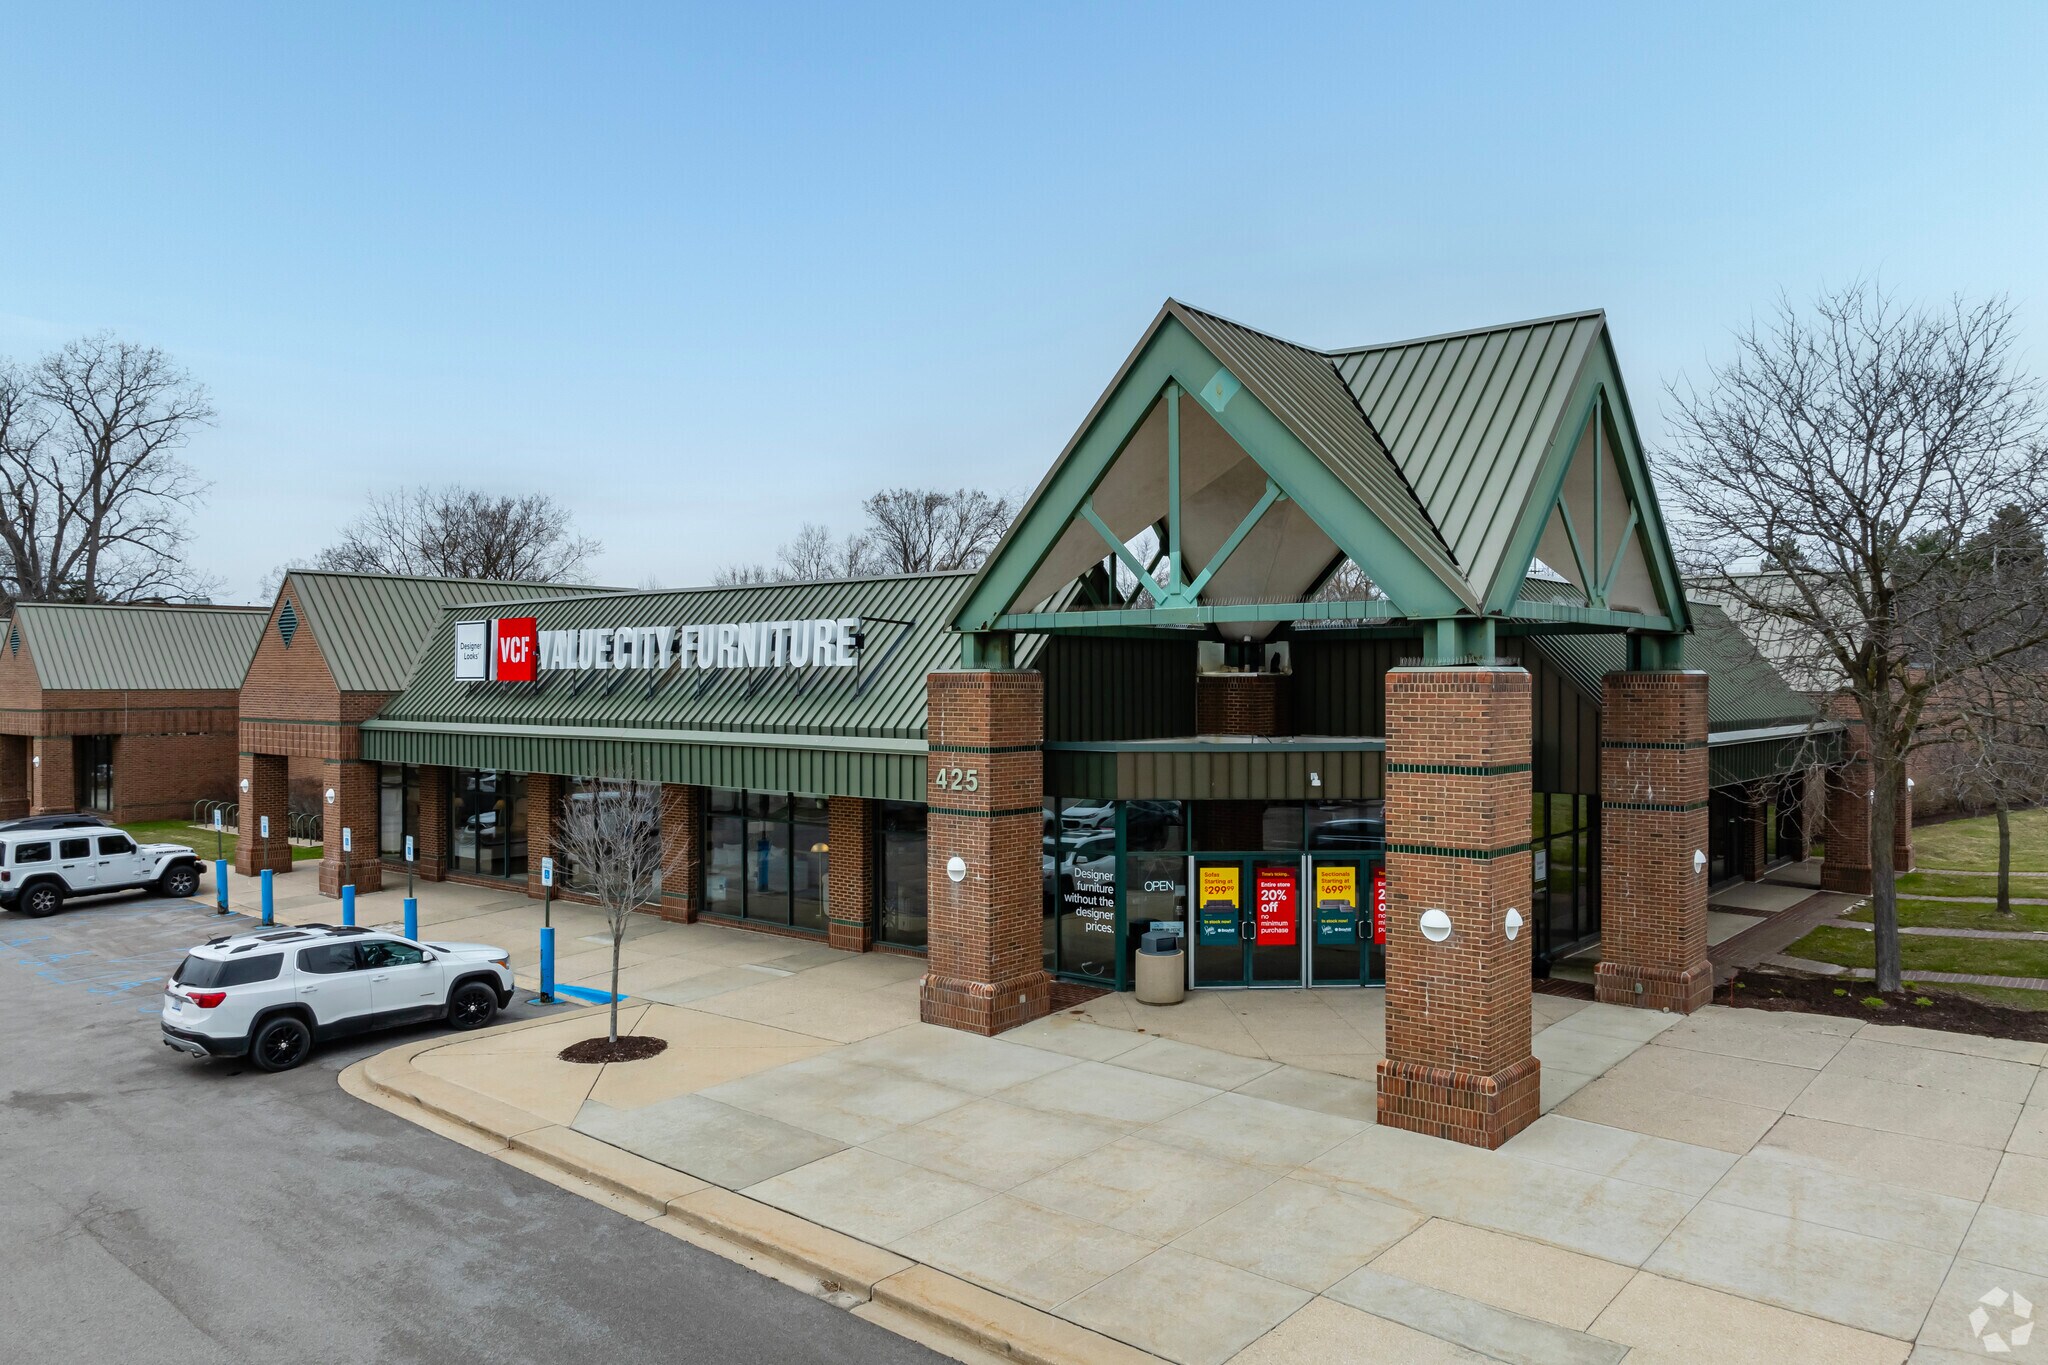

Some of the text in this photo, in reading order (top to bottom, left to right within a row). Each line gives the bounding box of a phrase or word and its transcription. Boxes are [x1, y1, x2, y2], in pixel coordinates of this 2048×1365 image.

[460, 642, 482, 651] Designer
[500, 636, 530, 663] VCF
[538, 617, 859, 670] VALUE CITY FURNITURE
[935, 768, 978, 792] 425
[1075, 867, 1114, 881] Designer
[1076, 880, 1114, 894] furniture
[1144, 880, 1174, 892] OPEN
[1064, 893, 1114, 907] without the
[1260, 889, 1287, 901] 20%
[1075, 906, 1114, 921] designer
[1260, 901, 1279, 913] off
[1085, 921, 1115, 934] prices.
[1260, 927, 1289, 935] purchase
